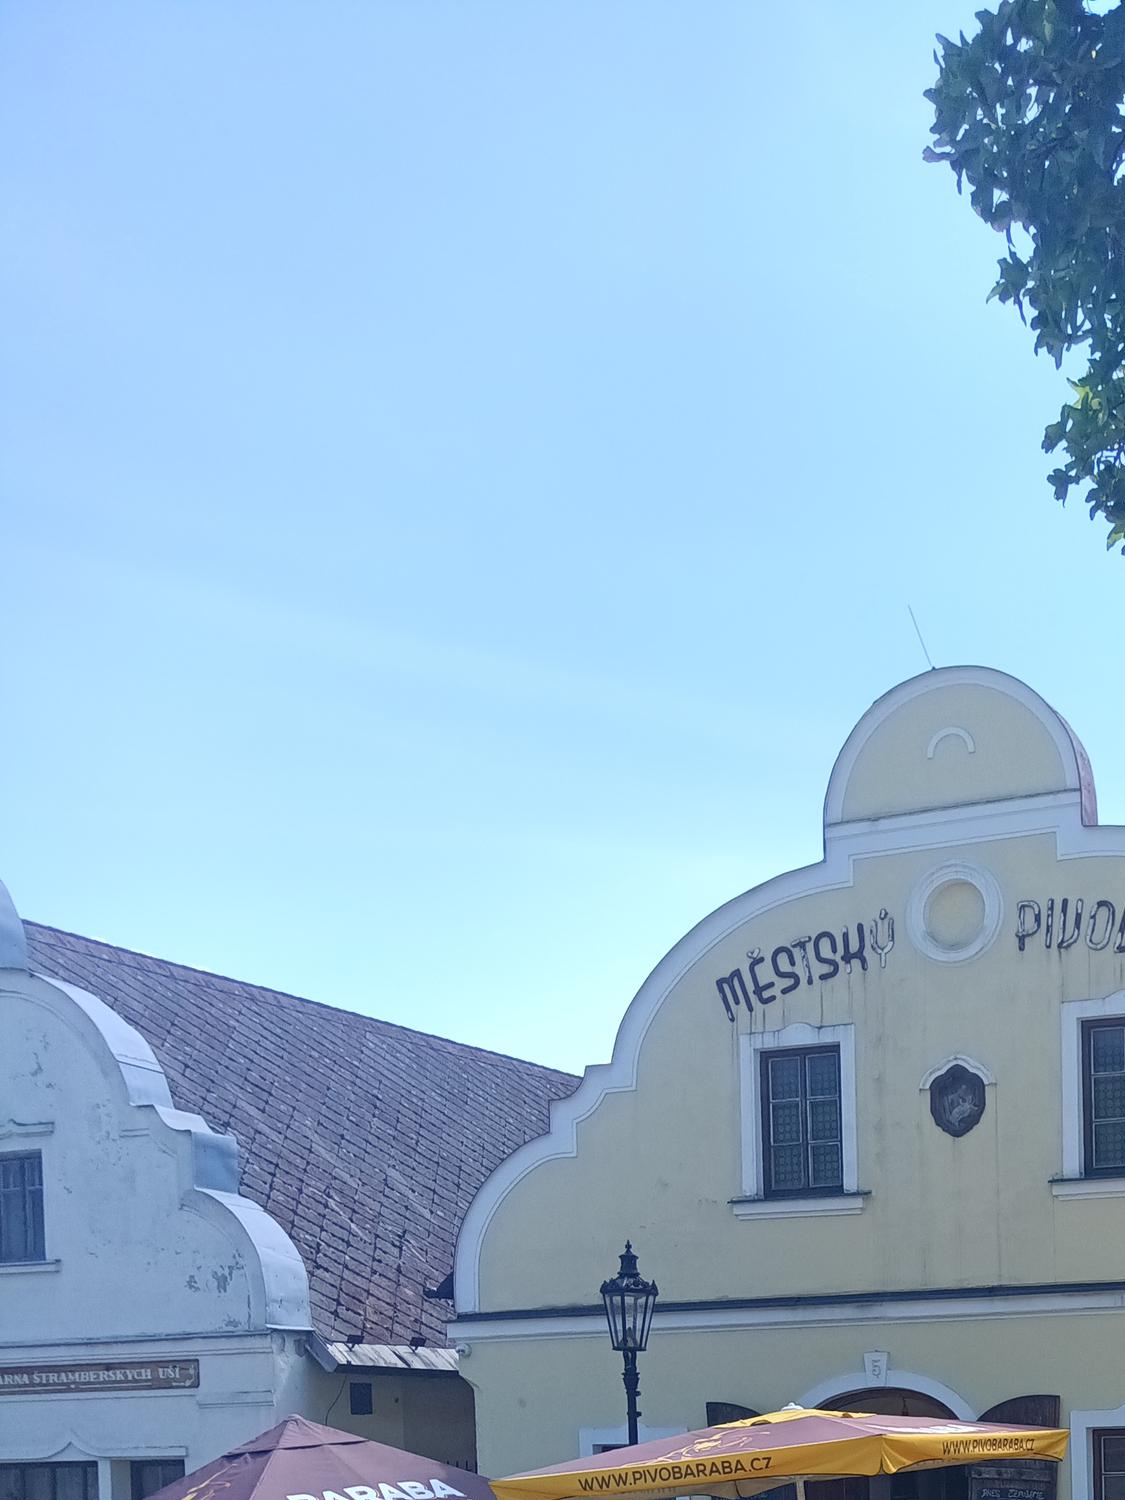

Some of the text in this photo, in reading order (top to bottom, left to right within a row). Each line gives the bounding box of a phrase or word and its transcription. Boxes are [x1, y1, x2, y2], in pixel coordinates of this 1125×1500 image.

[715, 908, 894, 1022] MĚSTSKÝ
[942, 1438, 1035, 1455] WWW.PIVOBARABA.CZ
[578, 1457, 773, 1492] WWW.PIVOBARABA.CZ
